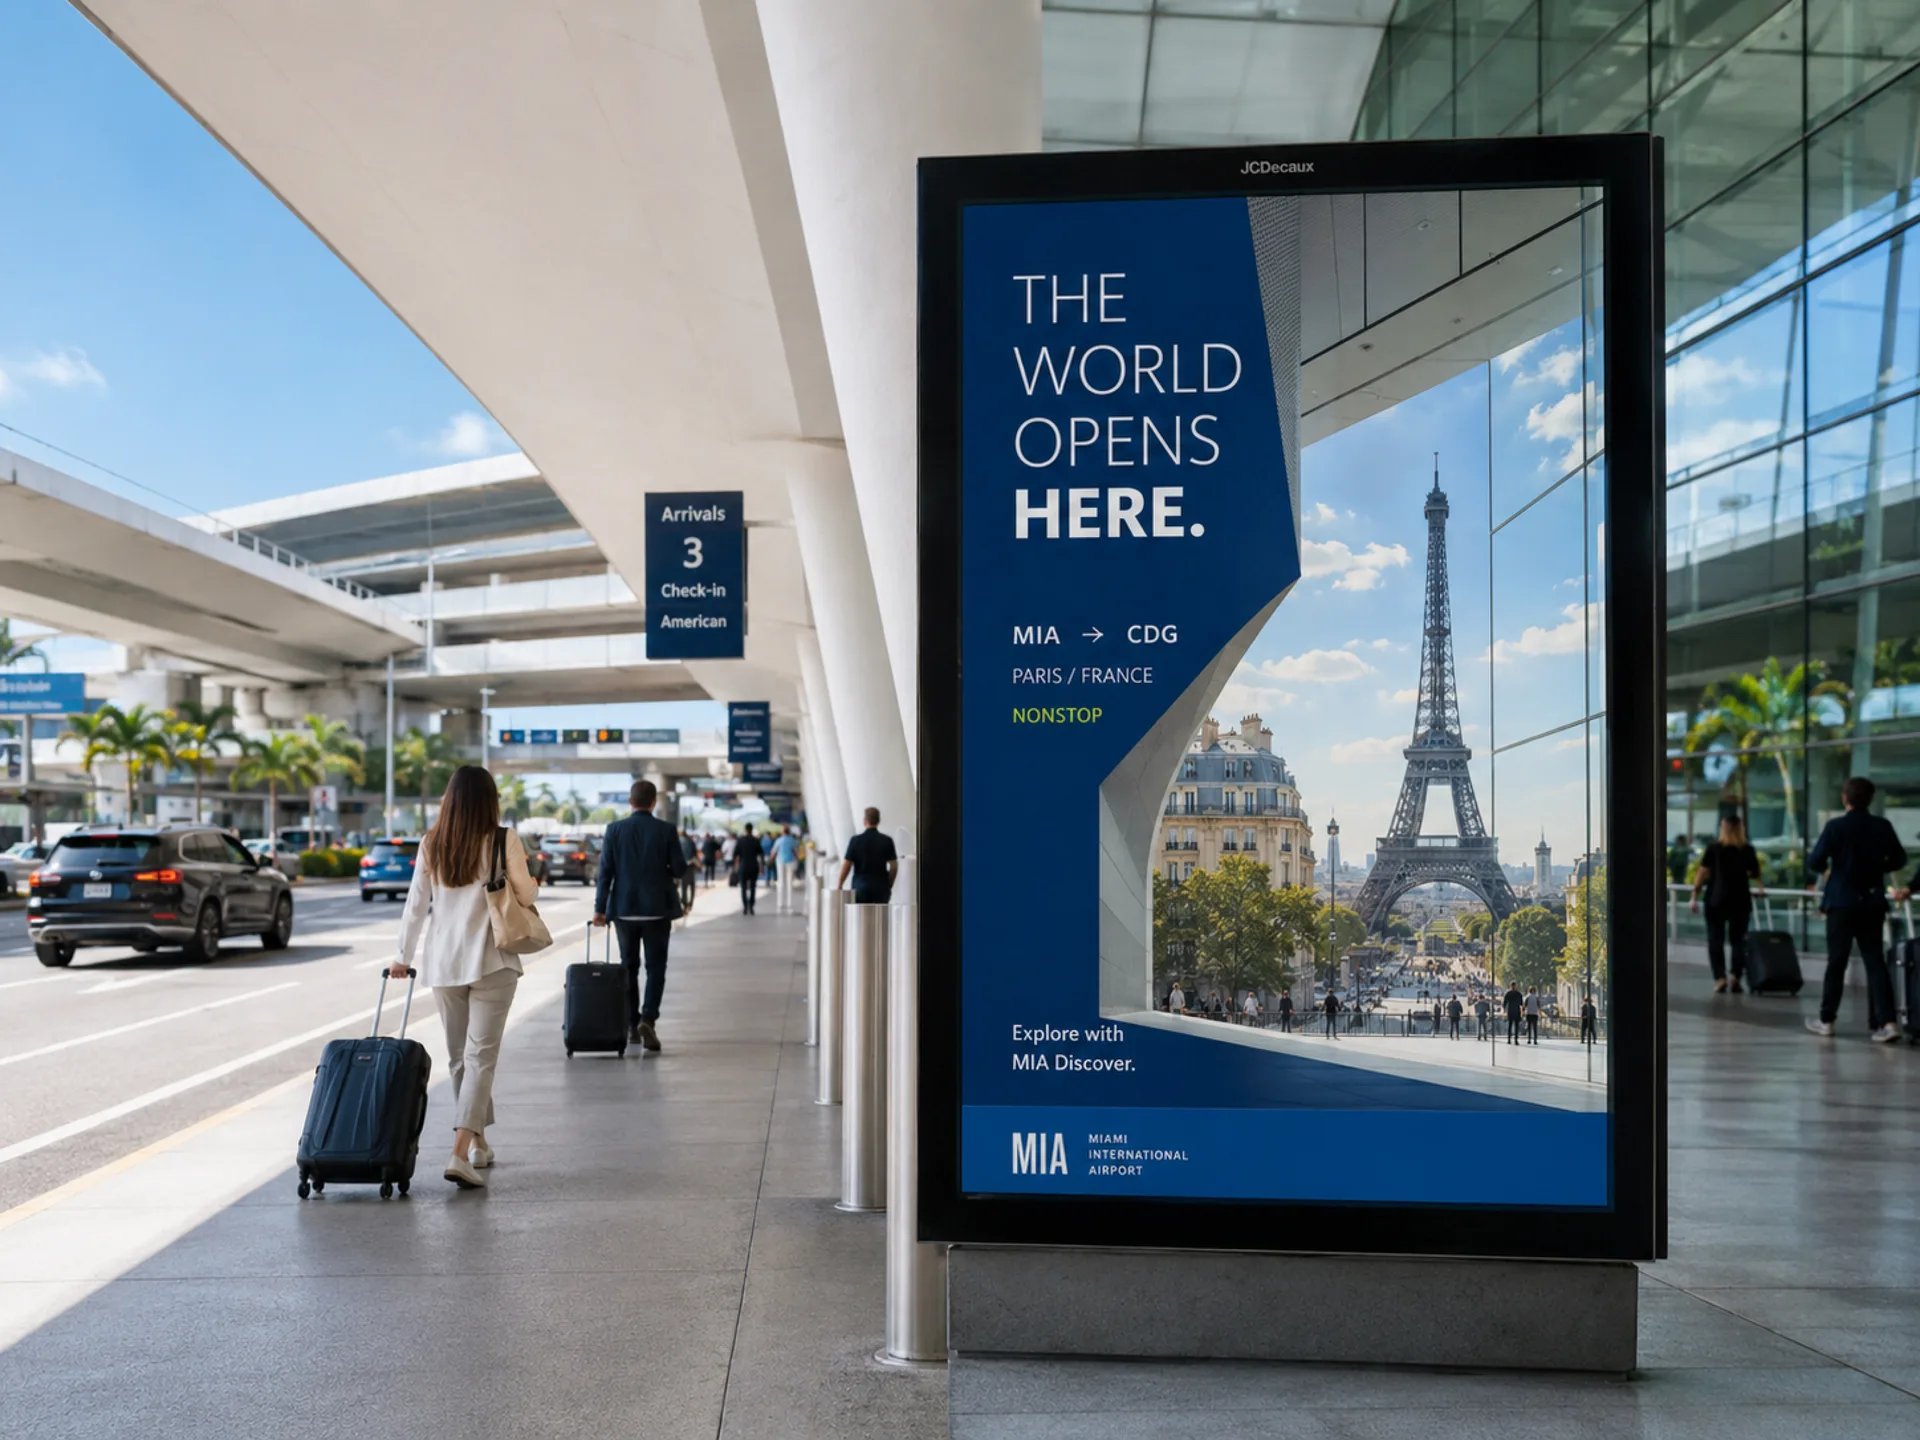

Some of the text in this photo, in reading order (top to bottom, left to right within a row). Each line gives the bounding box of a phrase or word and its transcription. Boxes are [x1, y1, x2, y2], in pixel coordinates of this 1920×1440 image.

[1240, 160, 1315, 175] JCDecaux
[1012, 272, 1127, 325] THE
[1013, 343, 1243, 396] WORLD
[1014, 414, 1221, 468] OPENS
[661, 504, 727, 523] Arrivals
[1015, 486, 1205, 539] HERE.
[682, 536, 704, 569] 3
[660, 582, 727, 599] Check-in
[660, 613, 728, 630] American
[1012, 624, 1178, 645] MIA CDG
[1012, 667, 1063, 685] PARIS
[1081, 666, 1153, 684] FRANCE
[1012, 707, 1103, 724] NONSTOP
[1012, 1023, 1125, 1046] Explore with
[1012, 1053, 1136, 1073] MIA Discover.
[1088, 1133, 1128, 1144] MIAMI
[1012, 1131, 1069, 1175] MIA
[1088, 1149, 1189, 1161] INTERNATIONAL
[1088, 1165, 1144, 1176] AIRPORT
